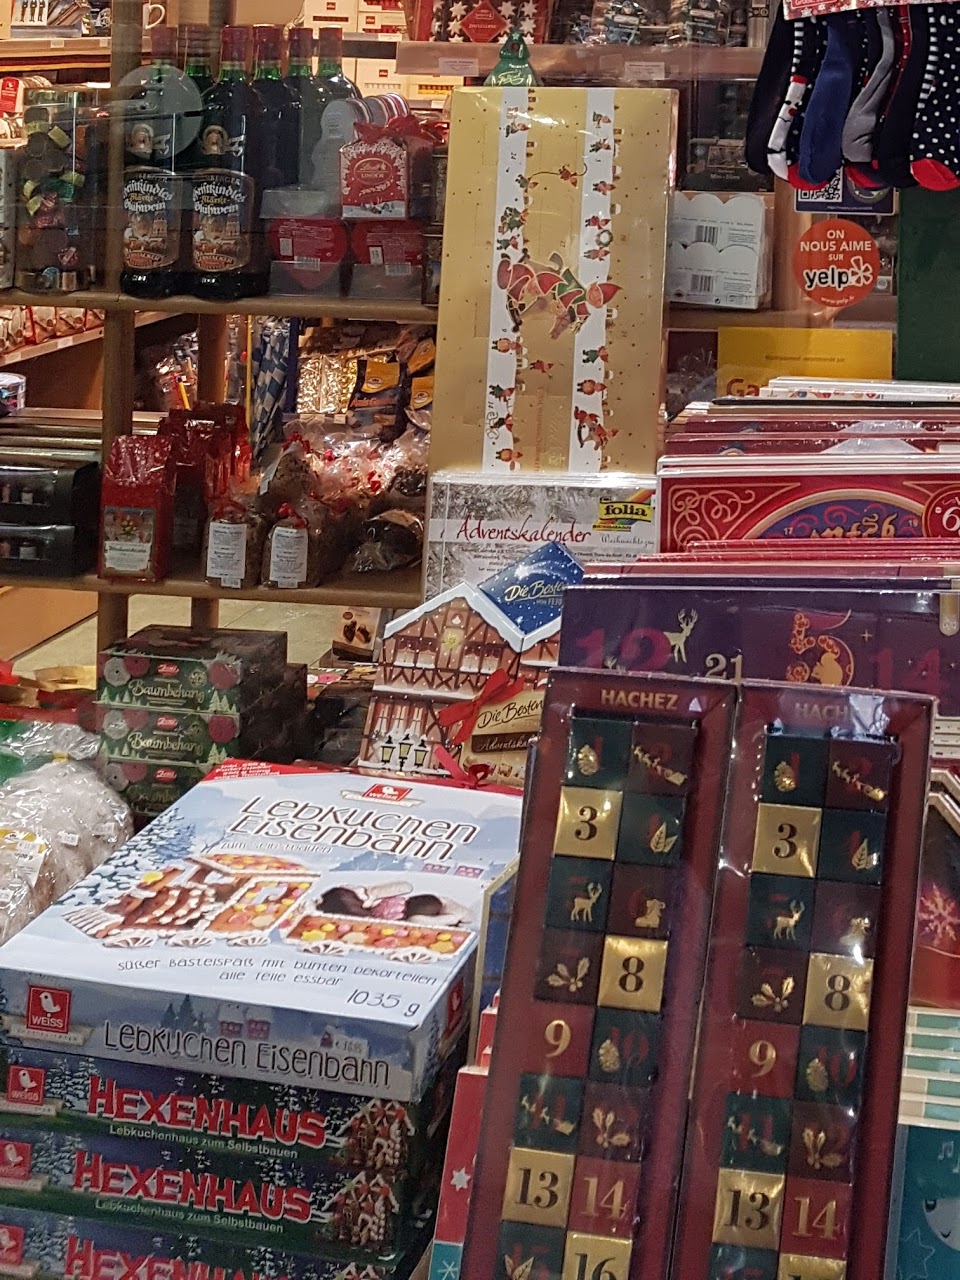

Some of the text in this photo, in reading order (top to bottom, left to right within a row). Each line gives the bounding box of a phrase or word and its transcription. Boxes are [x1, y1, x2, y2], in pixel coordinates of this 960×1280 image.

[800, 240, 872, 251] NOUS AIME
[827, 229, 845, 239] ON
[828, 253, 844, 261] SUR
[804, 267, 850, 289] yelp
[604, 502, 647, 518] folia
[456, 514, 592, 543] Adventskalender
[504, 583, 528, 603] Die
[705, 652, 744, 684] 21
[128, 678, 205, 703] Baumbehang
[601, 689, 679, 711] HACHEZ
[478, 700, 544, 729] Die Besten
[795, 701, 848, 721] HACH
[127, 730, 204, 756] Baumbehang
[240, 796, 479, 846] Lebkuchen
[574, 806, 598, 841] 3
[228, 815, 455, 861] Eisenbahn
[772, 822, 799, 859] 3
[219, 971, 246, 982] alle
[293, 974, 343, 987] essbar
[261, 959, 285, 968] mit
[293, 961, 347, 974] bunten
[618, 956, 645, 993] 8
[347, 988, 421, 1017] 1035 g
[824, 973, 851, 1011] 8
[31, 1015, 64, 1029] WEISS
[104, 1021, 247, 1067] Lebkuchen
[257, 1042, 391, 1088] Eisenbahn
[544, 1019, 572, 1058] 9
[748, 1040, 777, 1078] 9
[10, 1090, 40, 1102] WEISS
[87, 1075, 328, 1149] HEXENHAUS
[109, 1124, 299, 1159] Lebkuchenhaus zum Selbstbauen
[72, 1149, 314, 1223] HEXENHAUS
[514, 1167, 560, 1210] 13
[582, 1176, 627, 1219] 14
[95, 1199, 284, 1234] Lebkuchenhaus zum Selbstbauen
[724, 1188, 770, 1231] 13
[791, 1196, 840, 1241] 14
